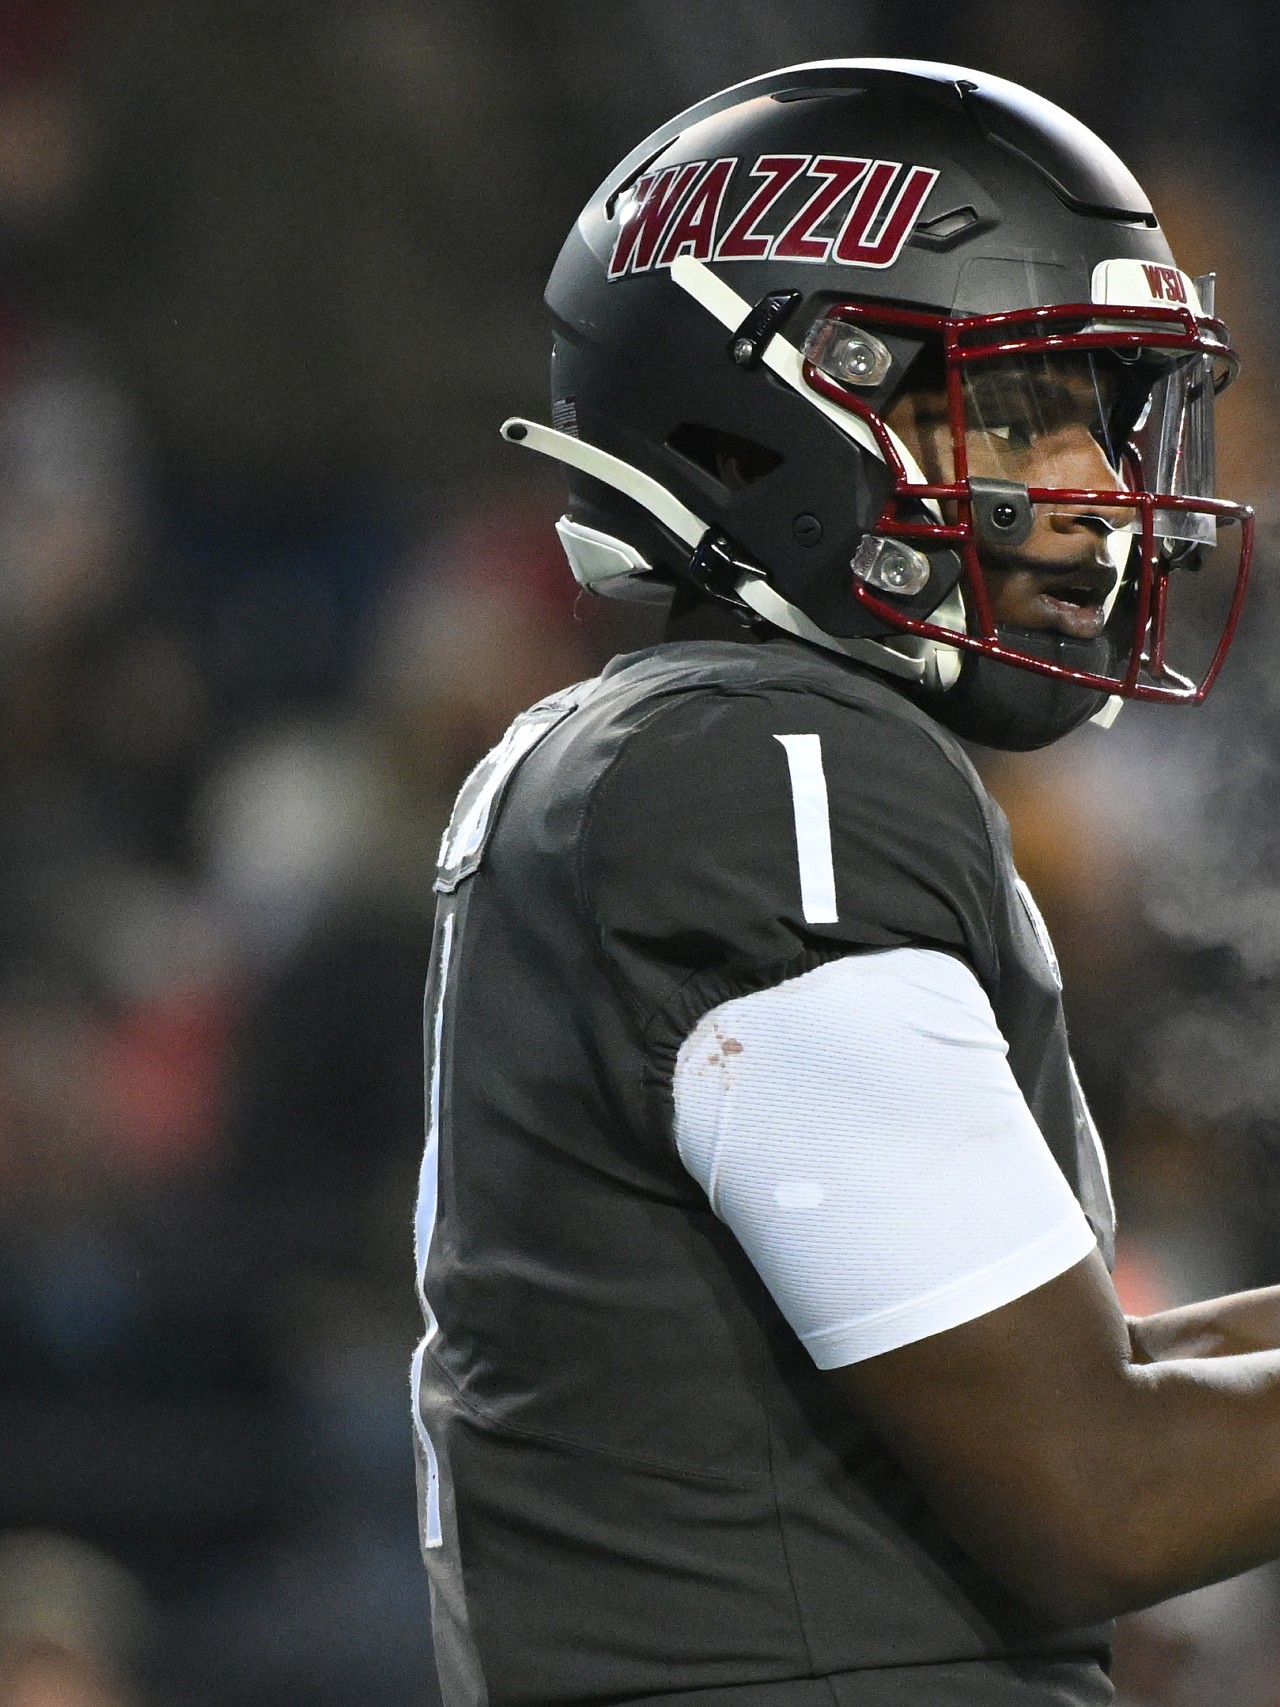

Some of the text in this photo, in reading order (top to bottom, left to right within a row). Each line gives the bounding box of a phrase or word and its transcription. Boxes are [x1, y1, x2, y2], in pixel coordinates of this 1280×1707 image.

[607, 154, 941, 279] WAZZU
[1141, 264, 1188, 303] WSU
[772, 733, 839, 924] 1
